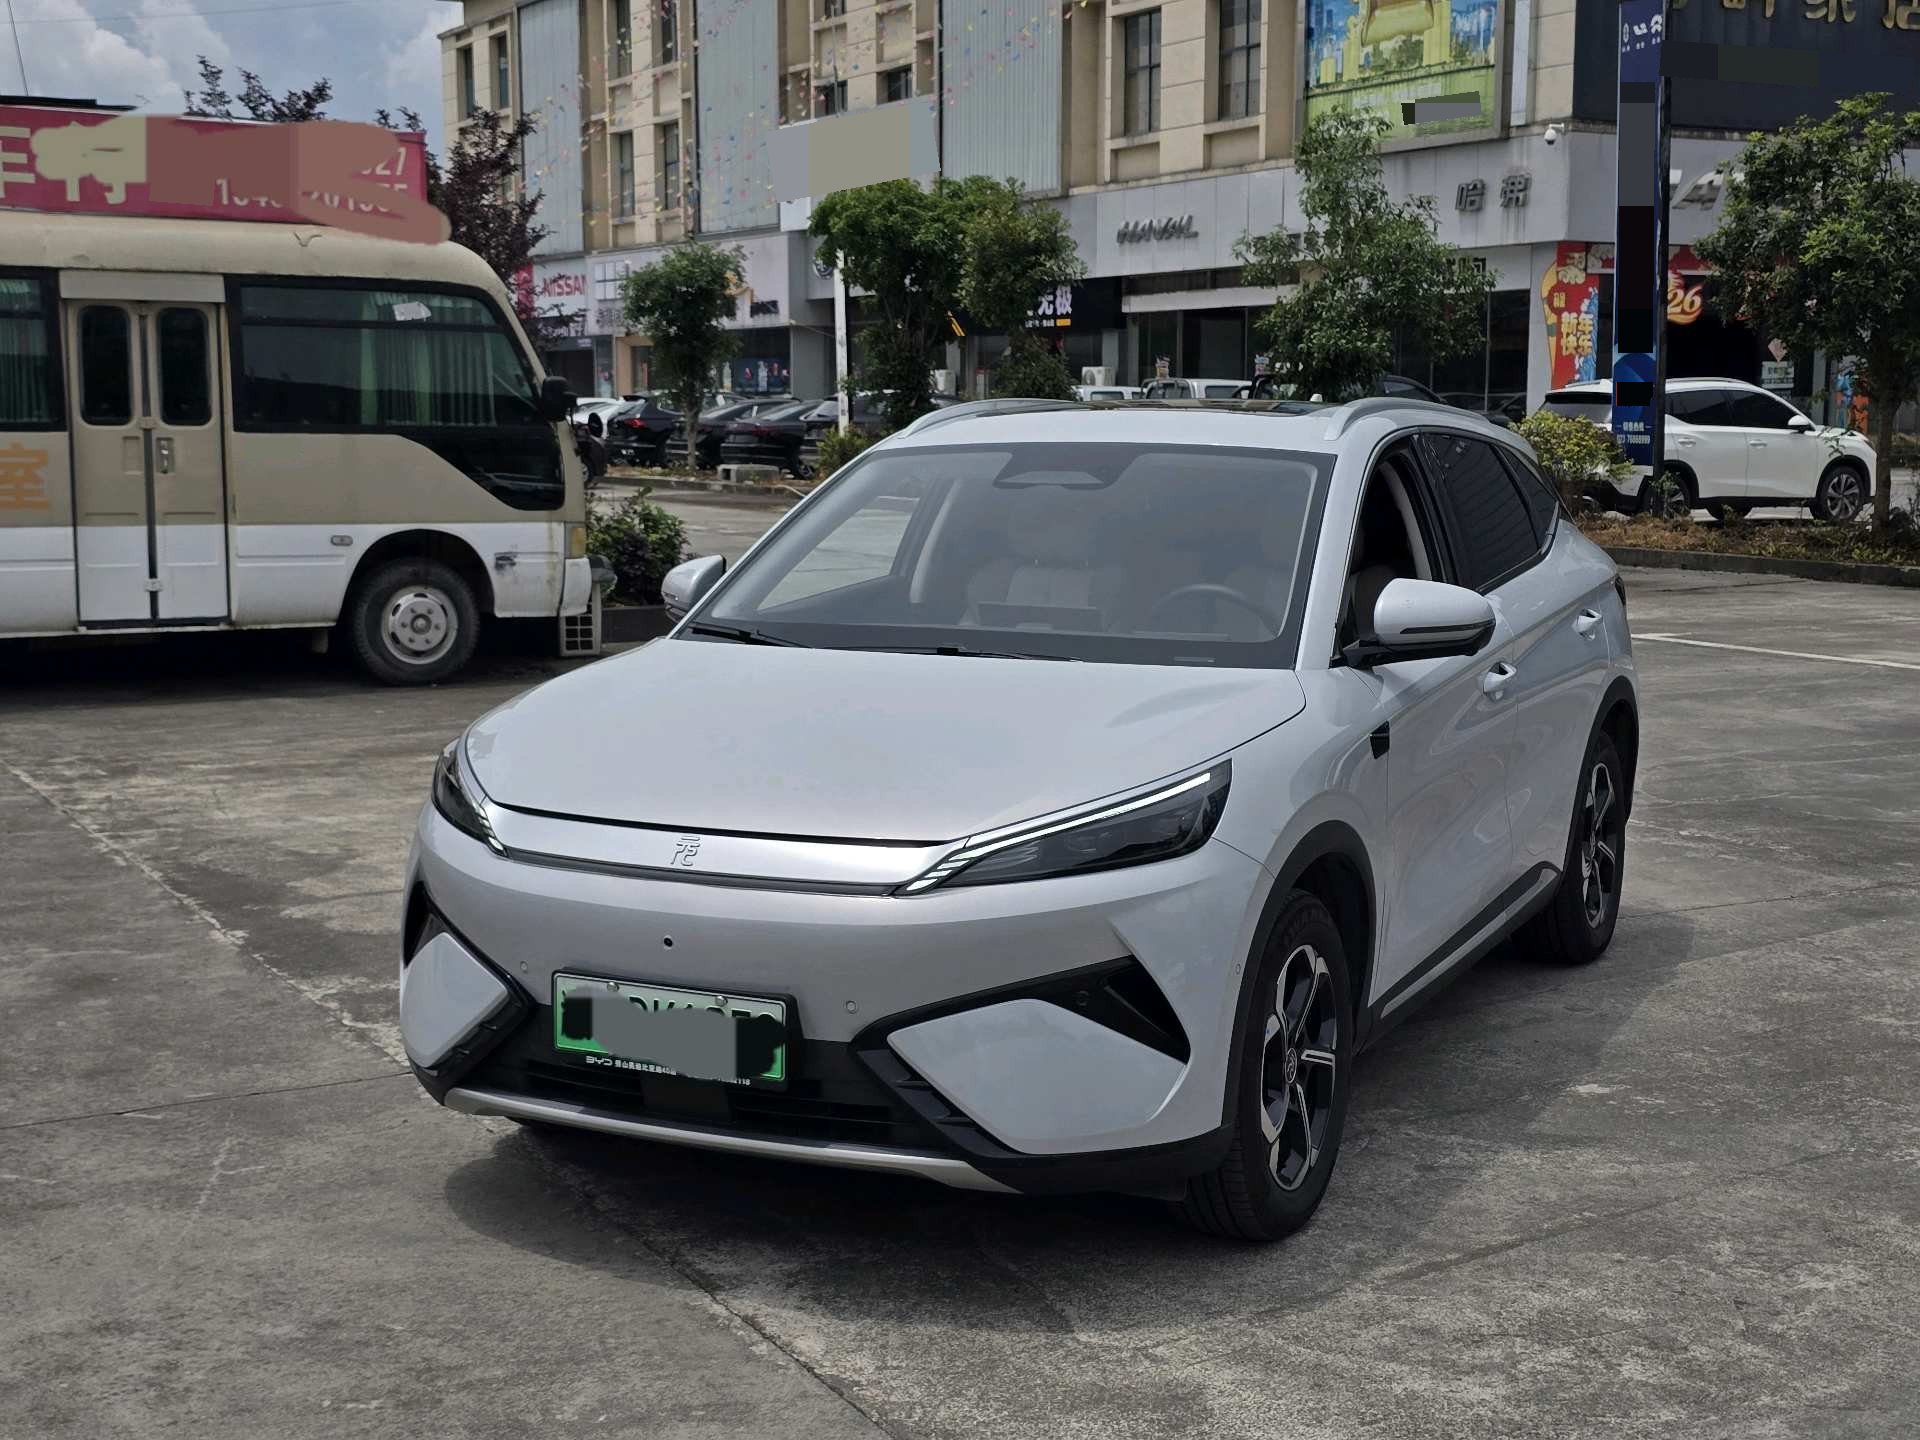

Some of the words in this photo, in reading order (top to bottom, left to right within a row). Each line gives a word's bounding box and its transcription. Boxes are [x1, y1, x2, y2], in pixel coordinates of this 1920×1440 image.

[1455, 174, 1531, 212] 哈弗
[1561, 312, 1594, 336] 新年
[1560, 334, 1593, 356] 快乐
